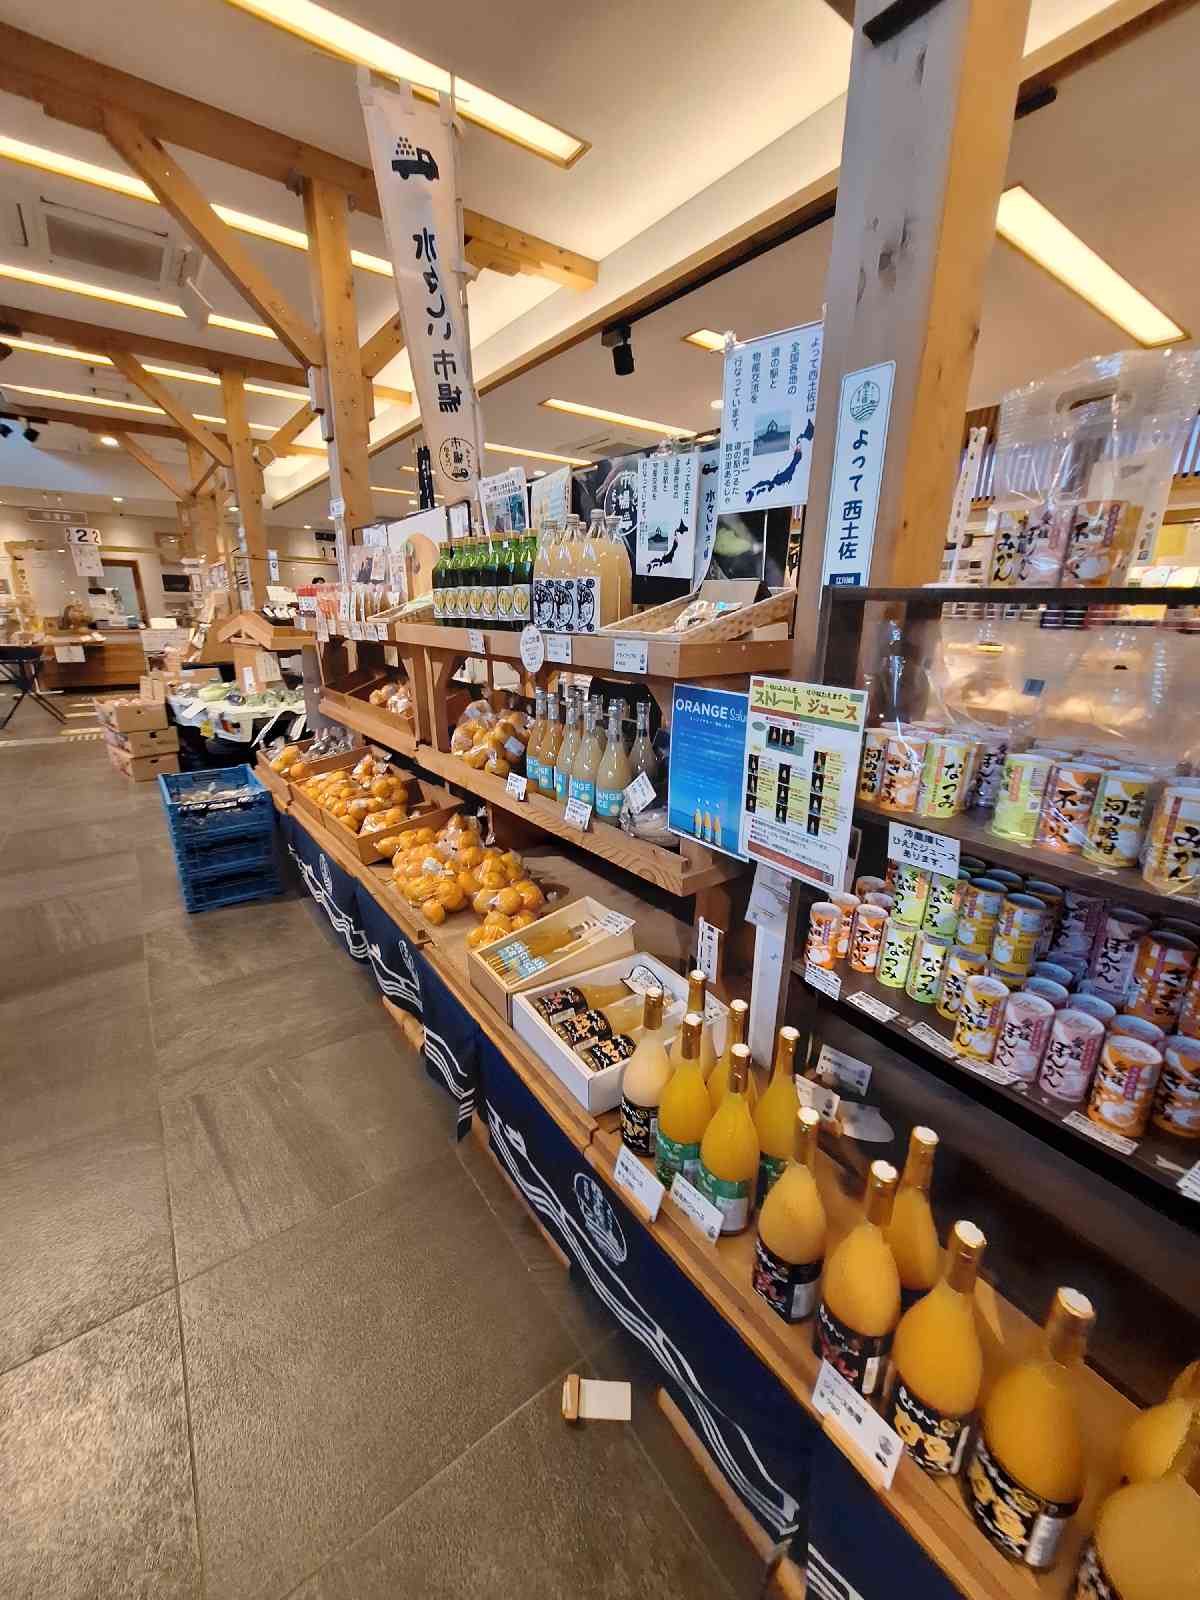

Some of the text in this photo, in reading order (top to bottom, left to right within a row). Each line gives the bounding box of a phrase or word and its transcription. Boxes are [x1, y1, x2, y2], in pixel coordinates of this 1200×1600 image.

[806, 336, 820, 413] よって西土佐は
[838, 429, 868, 560] よって西土佐
[75, 529, 88, 542] 2
[675, 698, 729, 719] ORANGE
[754, 690, 802, 712] ストレート
[807, 698, 858, 720] ジュース
[938, 762, 963, 809] なつみ
[892, 836, 957, 862] ひえたジュース
[903, 828, 946, 849] 冷蔵庫に
[902, 850, 944, 869] あります。
[882, 940, 905, 980] なつみ
[915, 956, 942, 997] なつみ
[997, 1021, 1021, 1067] ぽんかん
[1043, 1039, 1067, 1089] ぽんかん
